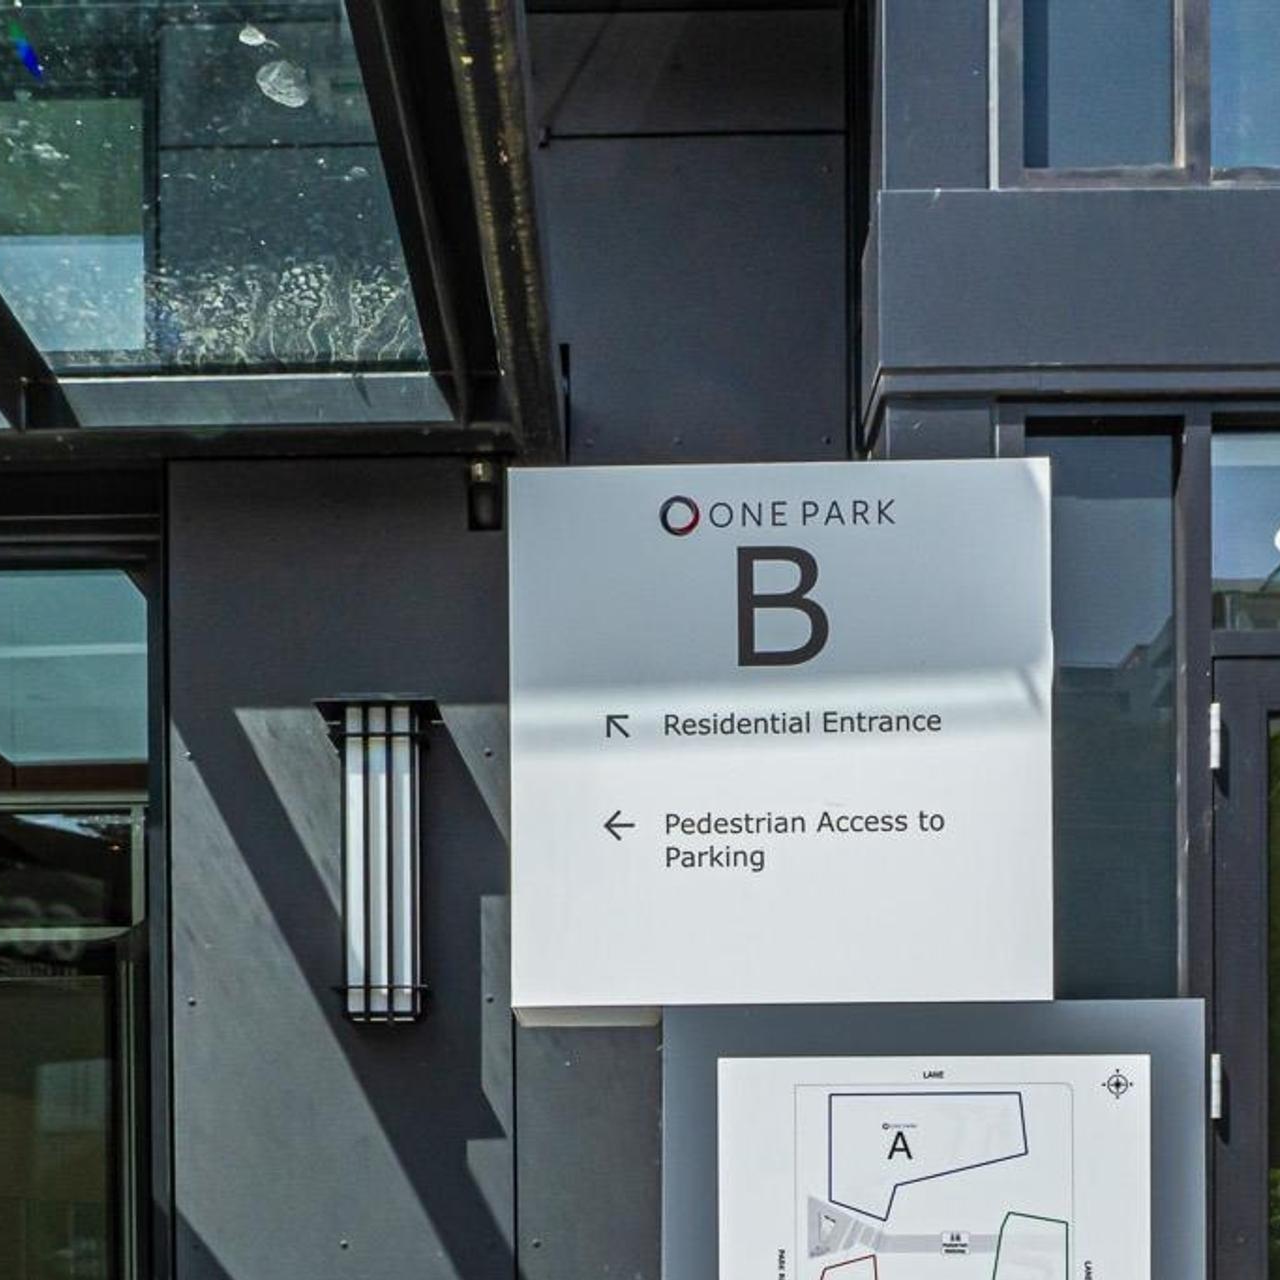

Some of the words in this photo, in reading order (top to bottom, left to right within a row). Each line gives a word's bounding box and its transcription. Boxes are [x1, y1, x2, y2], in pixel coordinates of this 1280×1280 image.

[709, 501, 787, 528] ONE
[802, 499, 895, 526] PARK
[737, 546, 829, 666] B
[665, 711, 810, 736] Residential
[823, 711, 941, 733] Entrance
[666, 812, 805, 835] Pedestrian
[817, 811, 907, 832] Access
[919, 811, 944, 831] to
[666, 845, 764, 872] Parking
[888, 1131, 912, 1159] A
